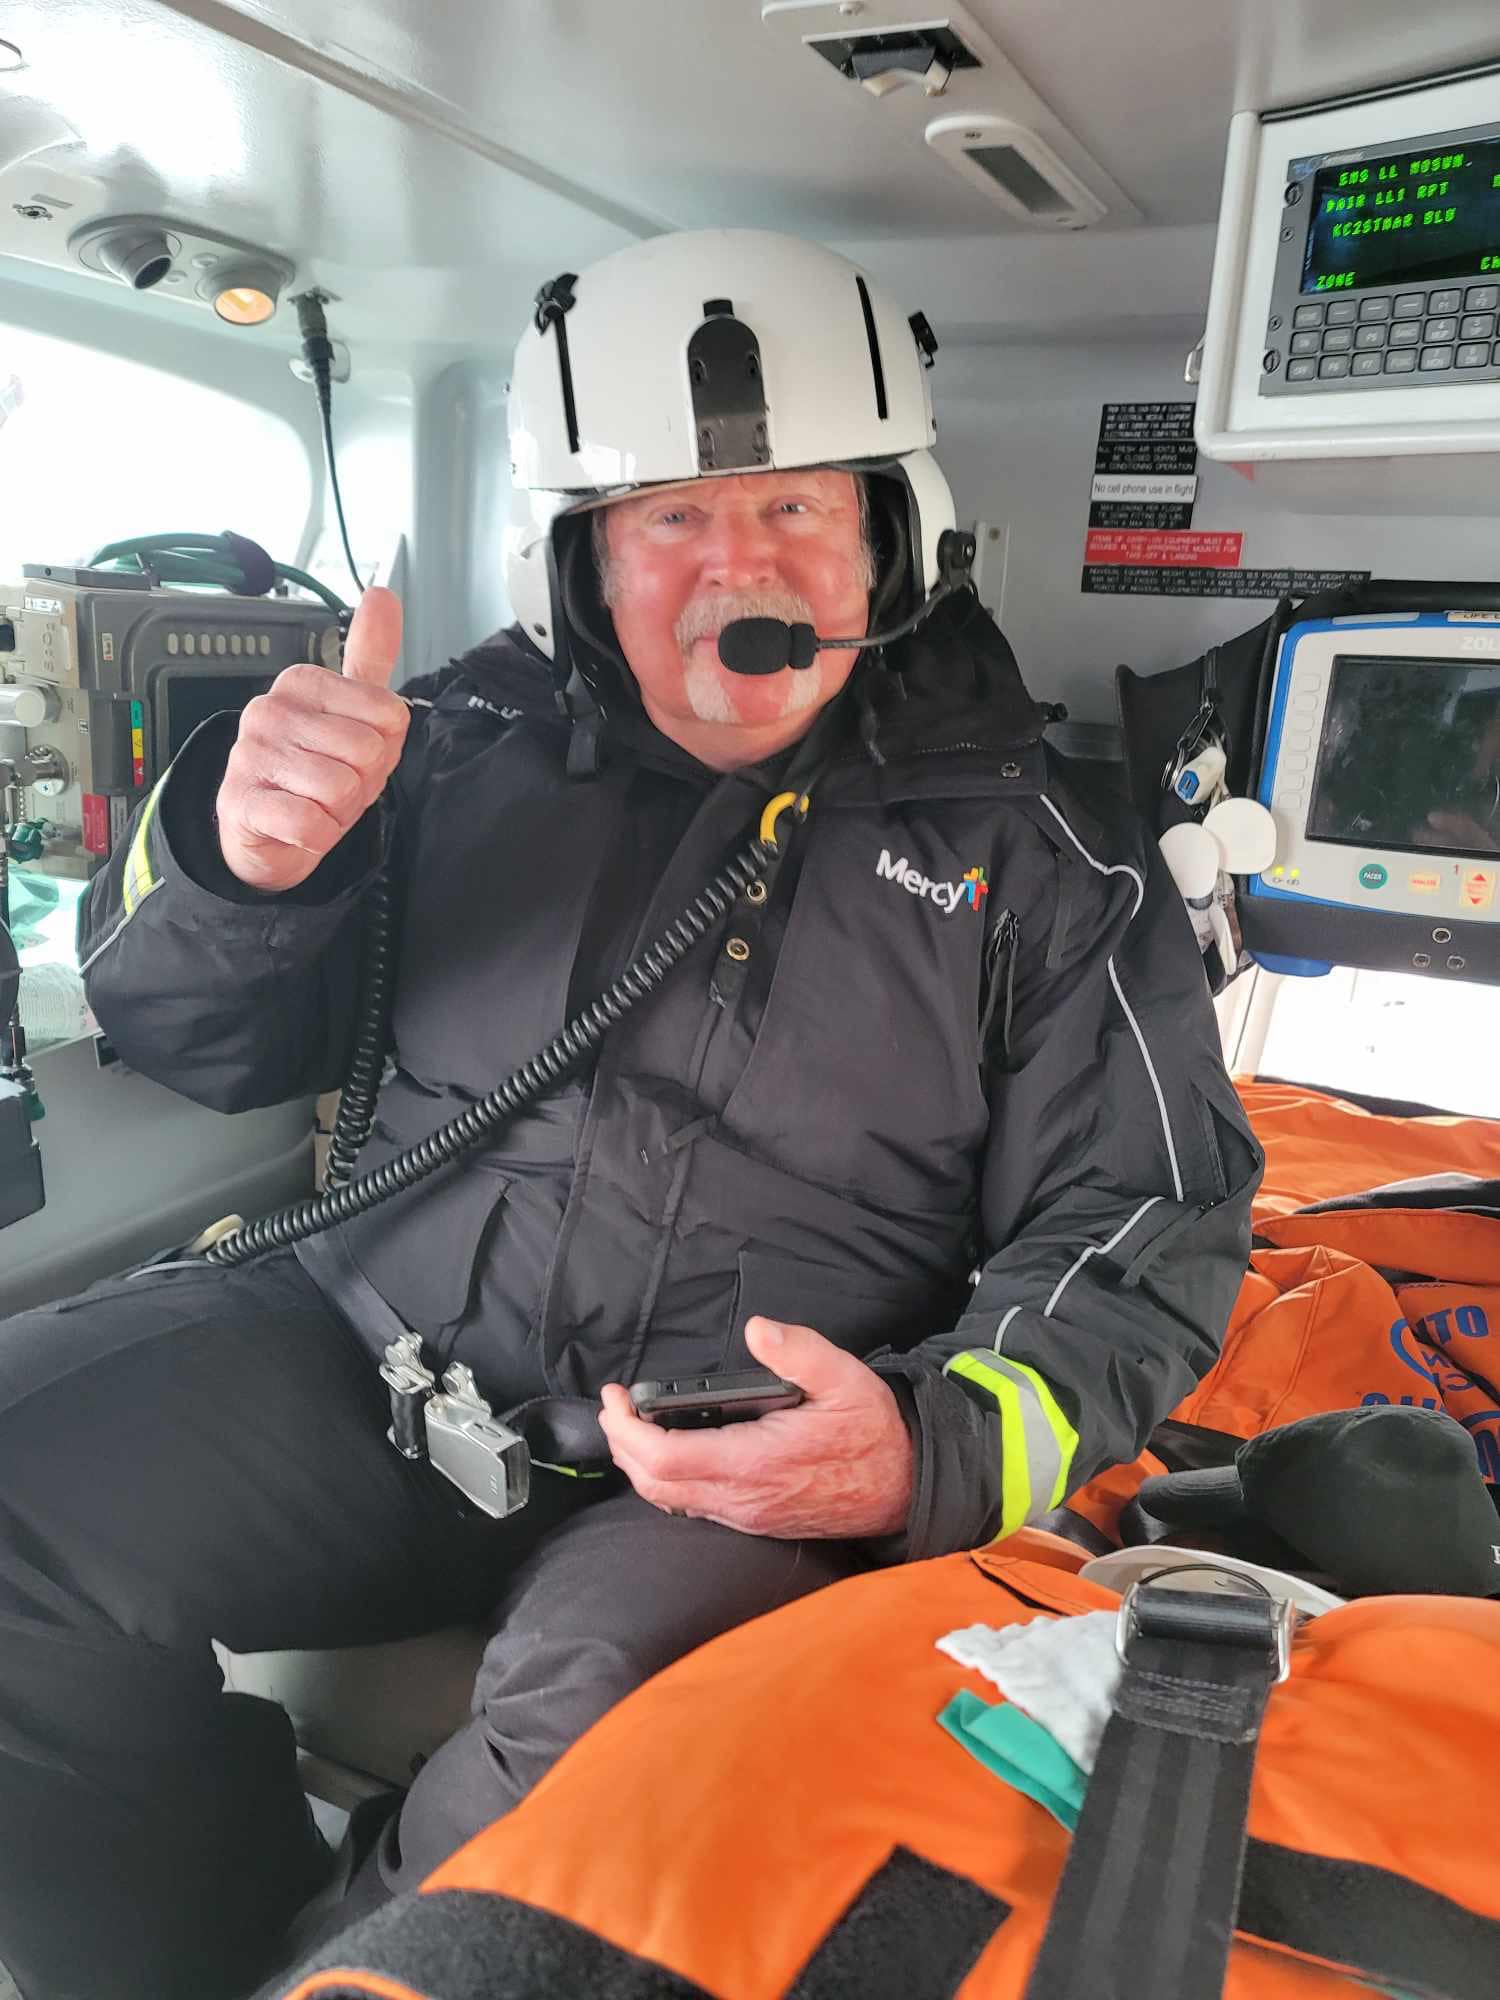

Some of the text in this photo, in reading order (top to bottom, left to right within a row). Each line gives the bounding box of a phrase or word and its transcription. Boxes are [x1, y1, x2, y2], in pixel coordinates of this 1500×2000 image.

[1316, 271, 1356, 289] ZONE
[1094, 482, 1194, 496] No cell phone use in flight
[876, 849, 966, 914] Mercy
